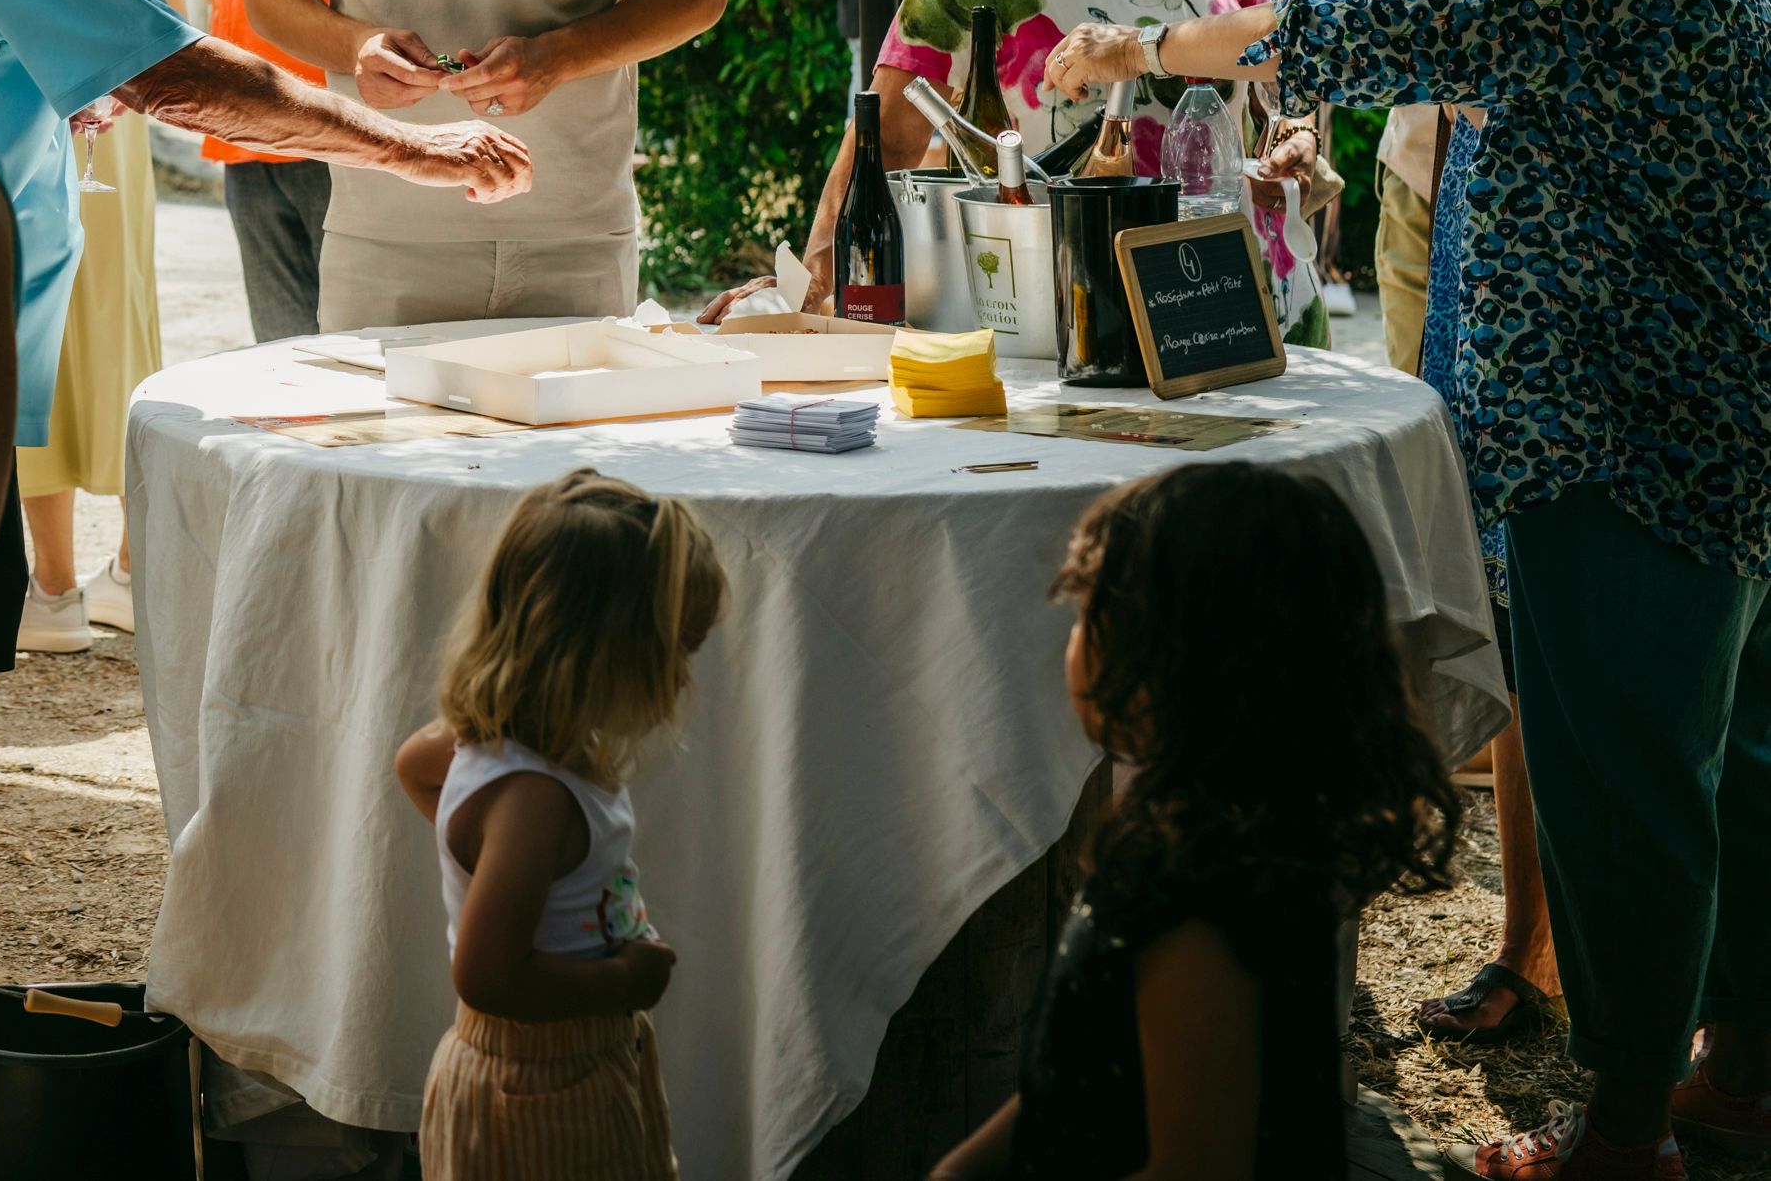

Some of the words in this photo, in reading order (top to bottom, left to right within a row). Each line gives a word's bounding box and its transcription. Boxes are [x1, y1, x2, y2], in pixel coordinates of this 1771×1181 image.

[1181, 247, 1196, 277] 4
[847, 304, 873, 312] ROUGE
[847, 312, 874, 320] CERISE
